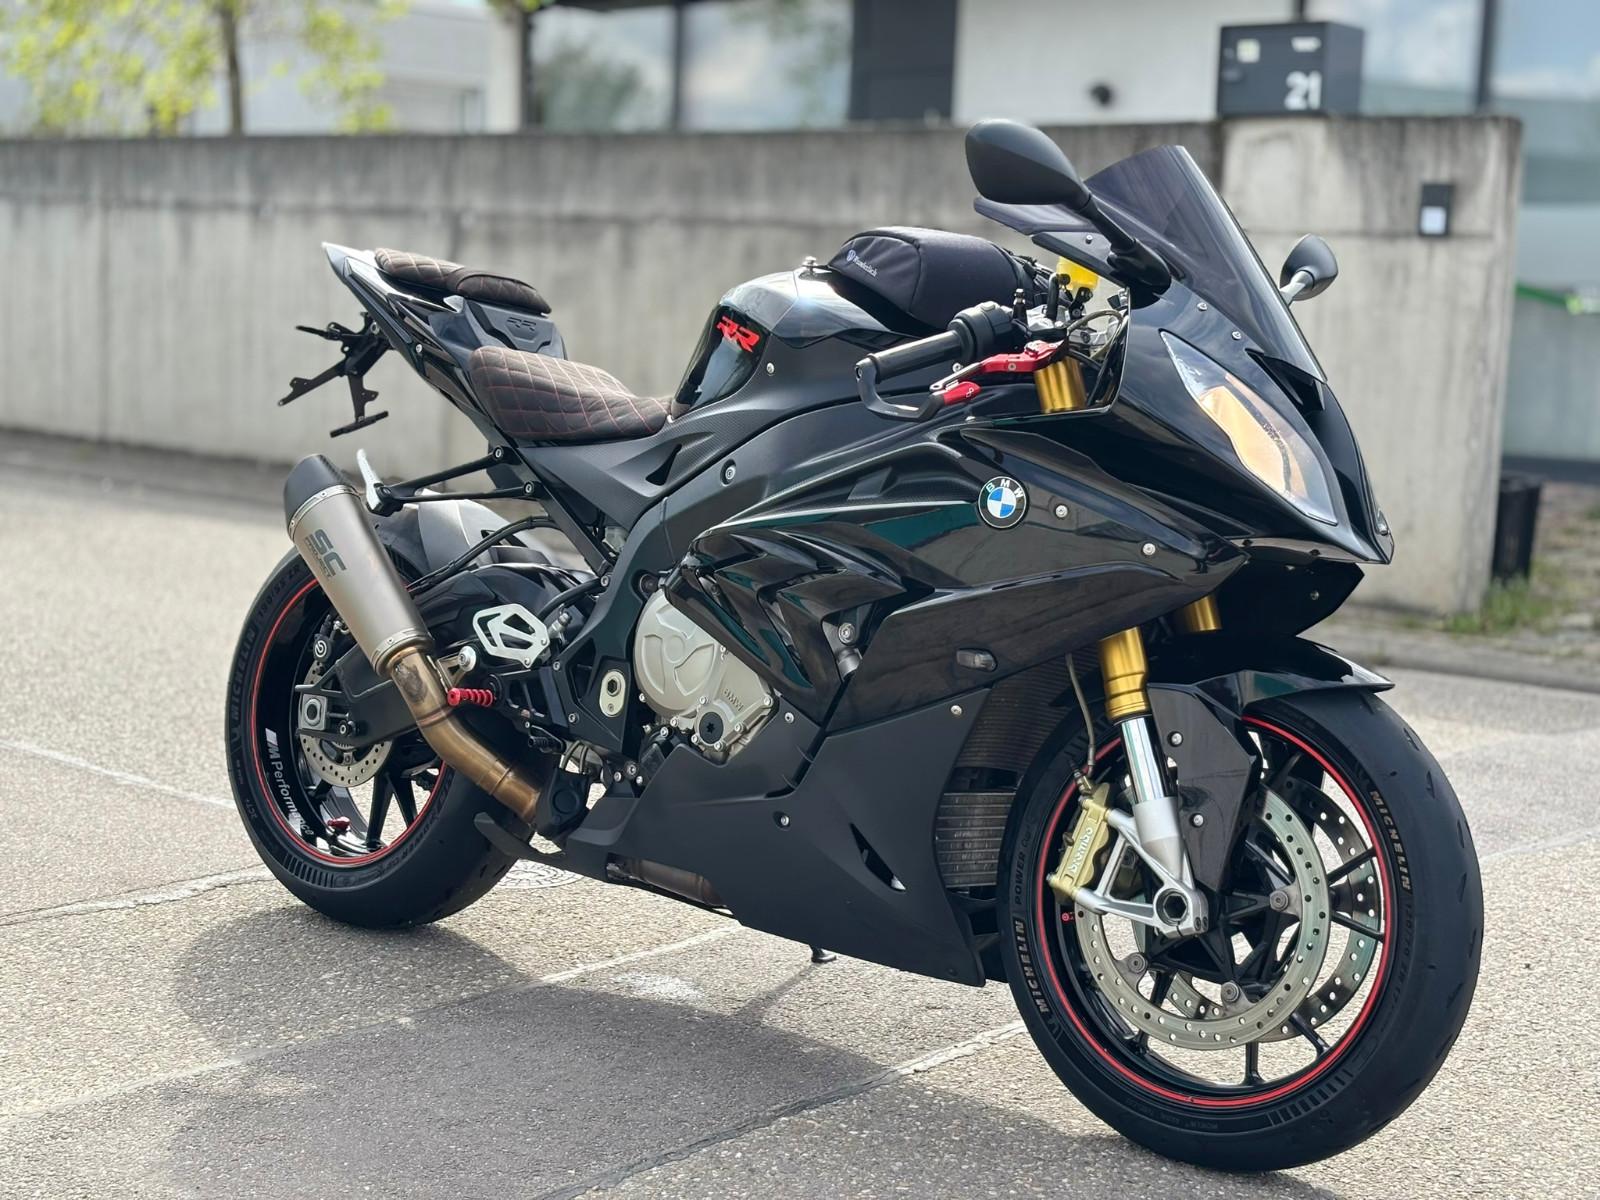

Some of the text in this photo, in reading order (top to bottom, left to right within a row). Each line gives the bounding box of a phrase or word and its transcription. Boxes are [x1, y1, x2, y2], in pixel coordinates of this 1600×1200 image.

[1284, 70, 1322, 111] 21
[309, 528, 346, 577] SC
[230, 626, 255, 720] MICHELIN
[722, 686, 746, 711] BMW
[1068, 827, 1093, 873] brembo
[1369, 787, 1410, 890] MICHELIN
[1014, 851, 1025, 904] POWER
[1014, 920, 1050, 1015] MICHELIN
